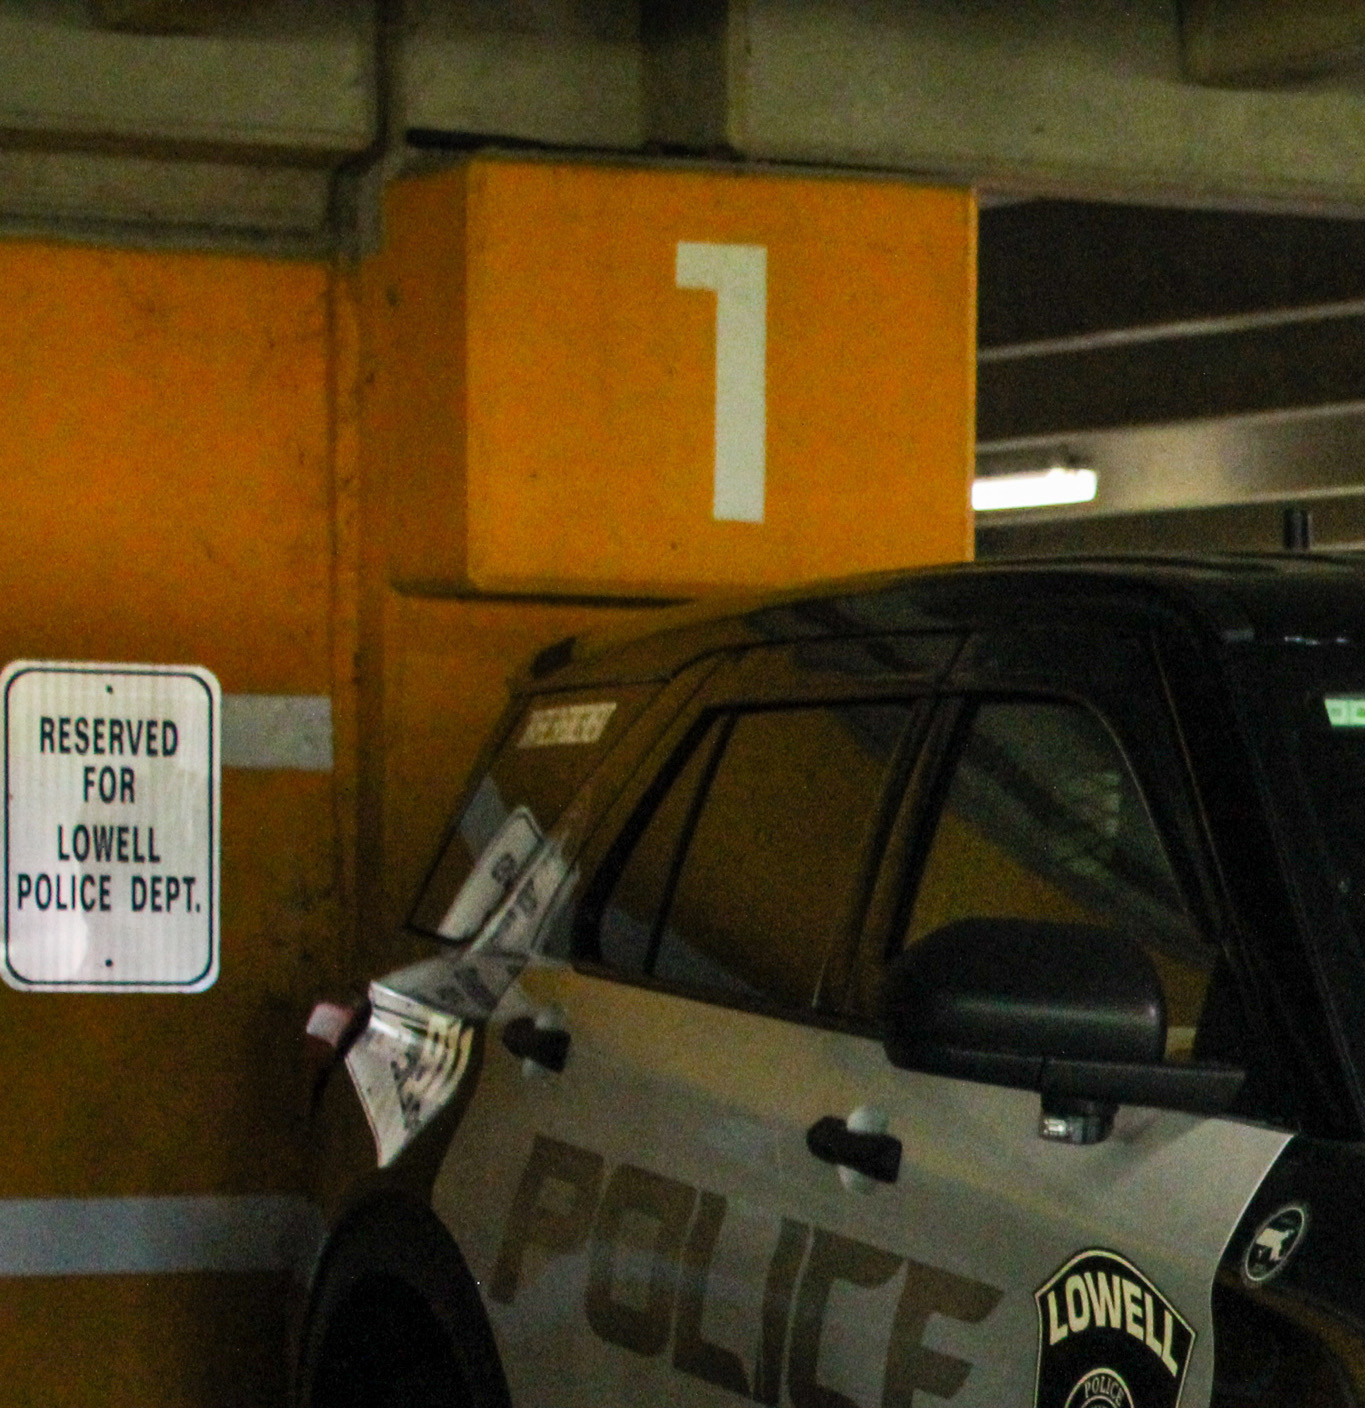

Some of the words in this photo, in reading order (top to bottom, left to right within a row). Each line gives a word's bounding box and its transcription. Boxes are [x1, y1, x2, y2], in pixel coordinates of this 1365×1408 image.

[675, 240, 768, 524] 1
[40, 716, 178, 756] RESERVED
[83, 766, 135, 803] FOR
[57, 824, 160, 862] LOWELL
[17, 873, 111, 911] POLICE
[131, 876, 200, 912] DEPT.
[1046, 1271, 1178, 1378] LOWELL
[1083, 1375, 1124, 1407] POLICE
